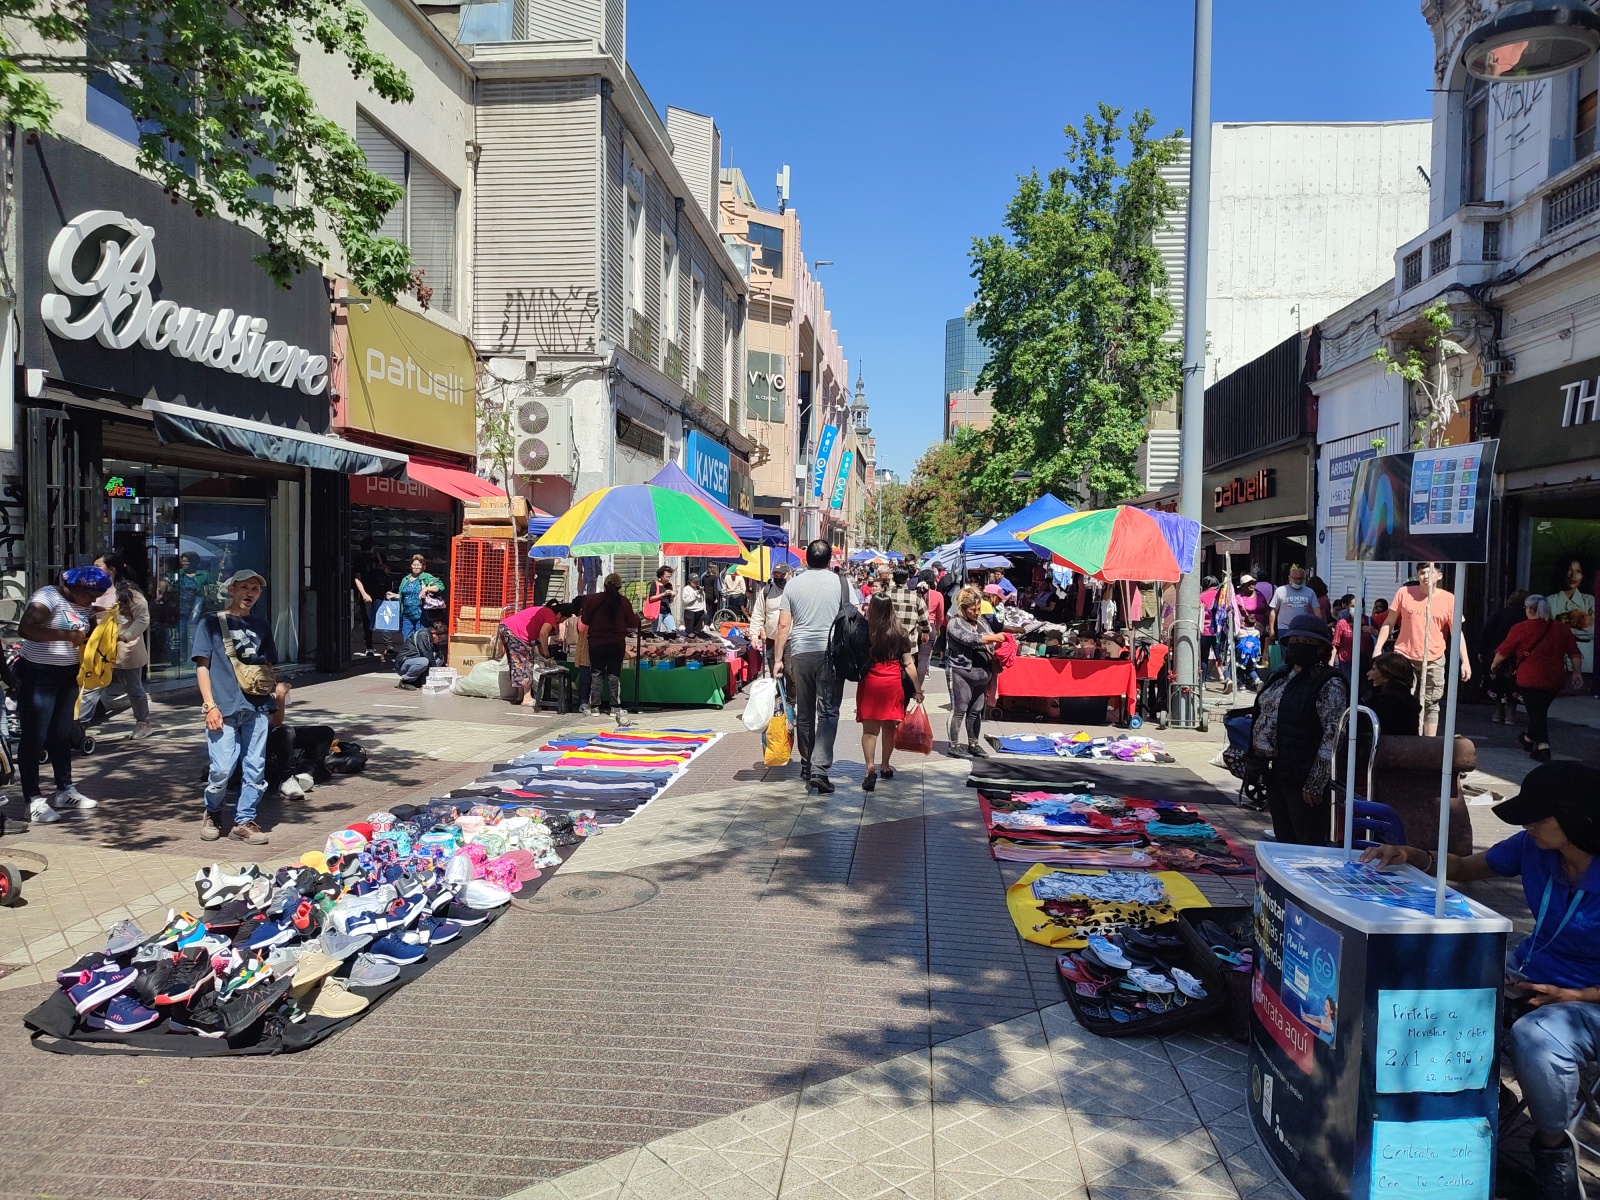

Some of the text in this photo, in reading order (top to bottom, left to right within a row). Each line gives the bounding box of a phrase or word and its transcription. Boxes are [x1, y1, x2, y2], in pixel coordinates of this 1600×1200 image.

[41, 209, 329, 396] Boussiere
[366, 346, 465, 407] patuelli
[696, 450, 729, 495] KAYSER
[833, 477, 846, 503] VIVO
[1213, 468, 1272, 513] patuelli
[1286, 595, 1309, 603] TOMMY
[1316, 956, 1332, 978] 5G
[1448, 1010, 1458, 1019] a
[1285, 1020, 1308, 1054] aquí
[1407, 1025, 1447, 1038] Movistar
[1455, 1031, 1463, 1041] y
[1382, 1143, 1474, 1160] Contrata solo
[1378, 1175, 1399, 1189] Con
